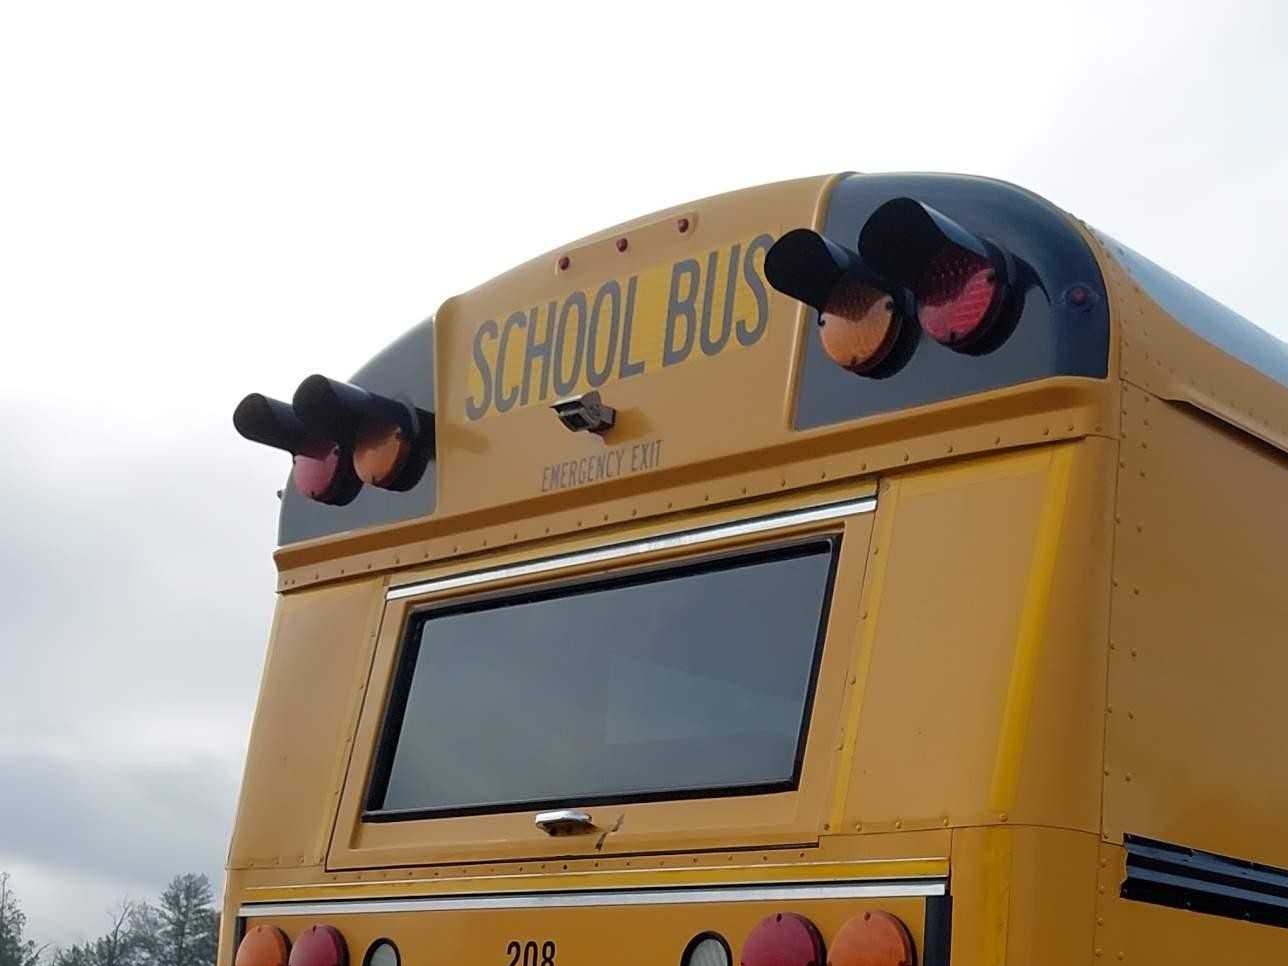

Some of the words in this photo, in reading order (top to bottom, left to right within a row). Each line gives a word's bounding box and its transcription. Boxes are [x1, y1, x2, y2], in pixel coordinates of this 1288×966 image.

[465, 277, 645, 422] SCHOOL
[662, 232, 774, 368] BUS
[541, 449, 625, 493] EMERGENCY
[630, 439, 663, 472] EXIT
